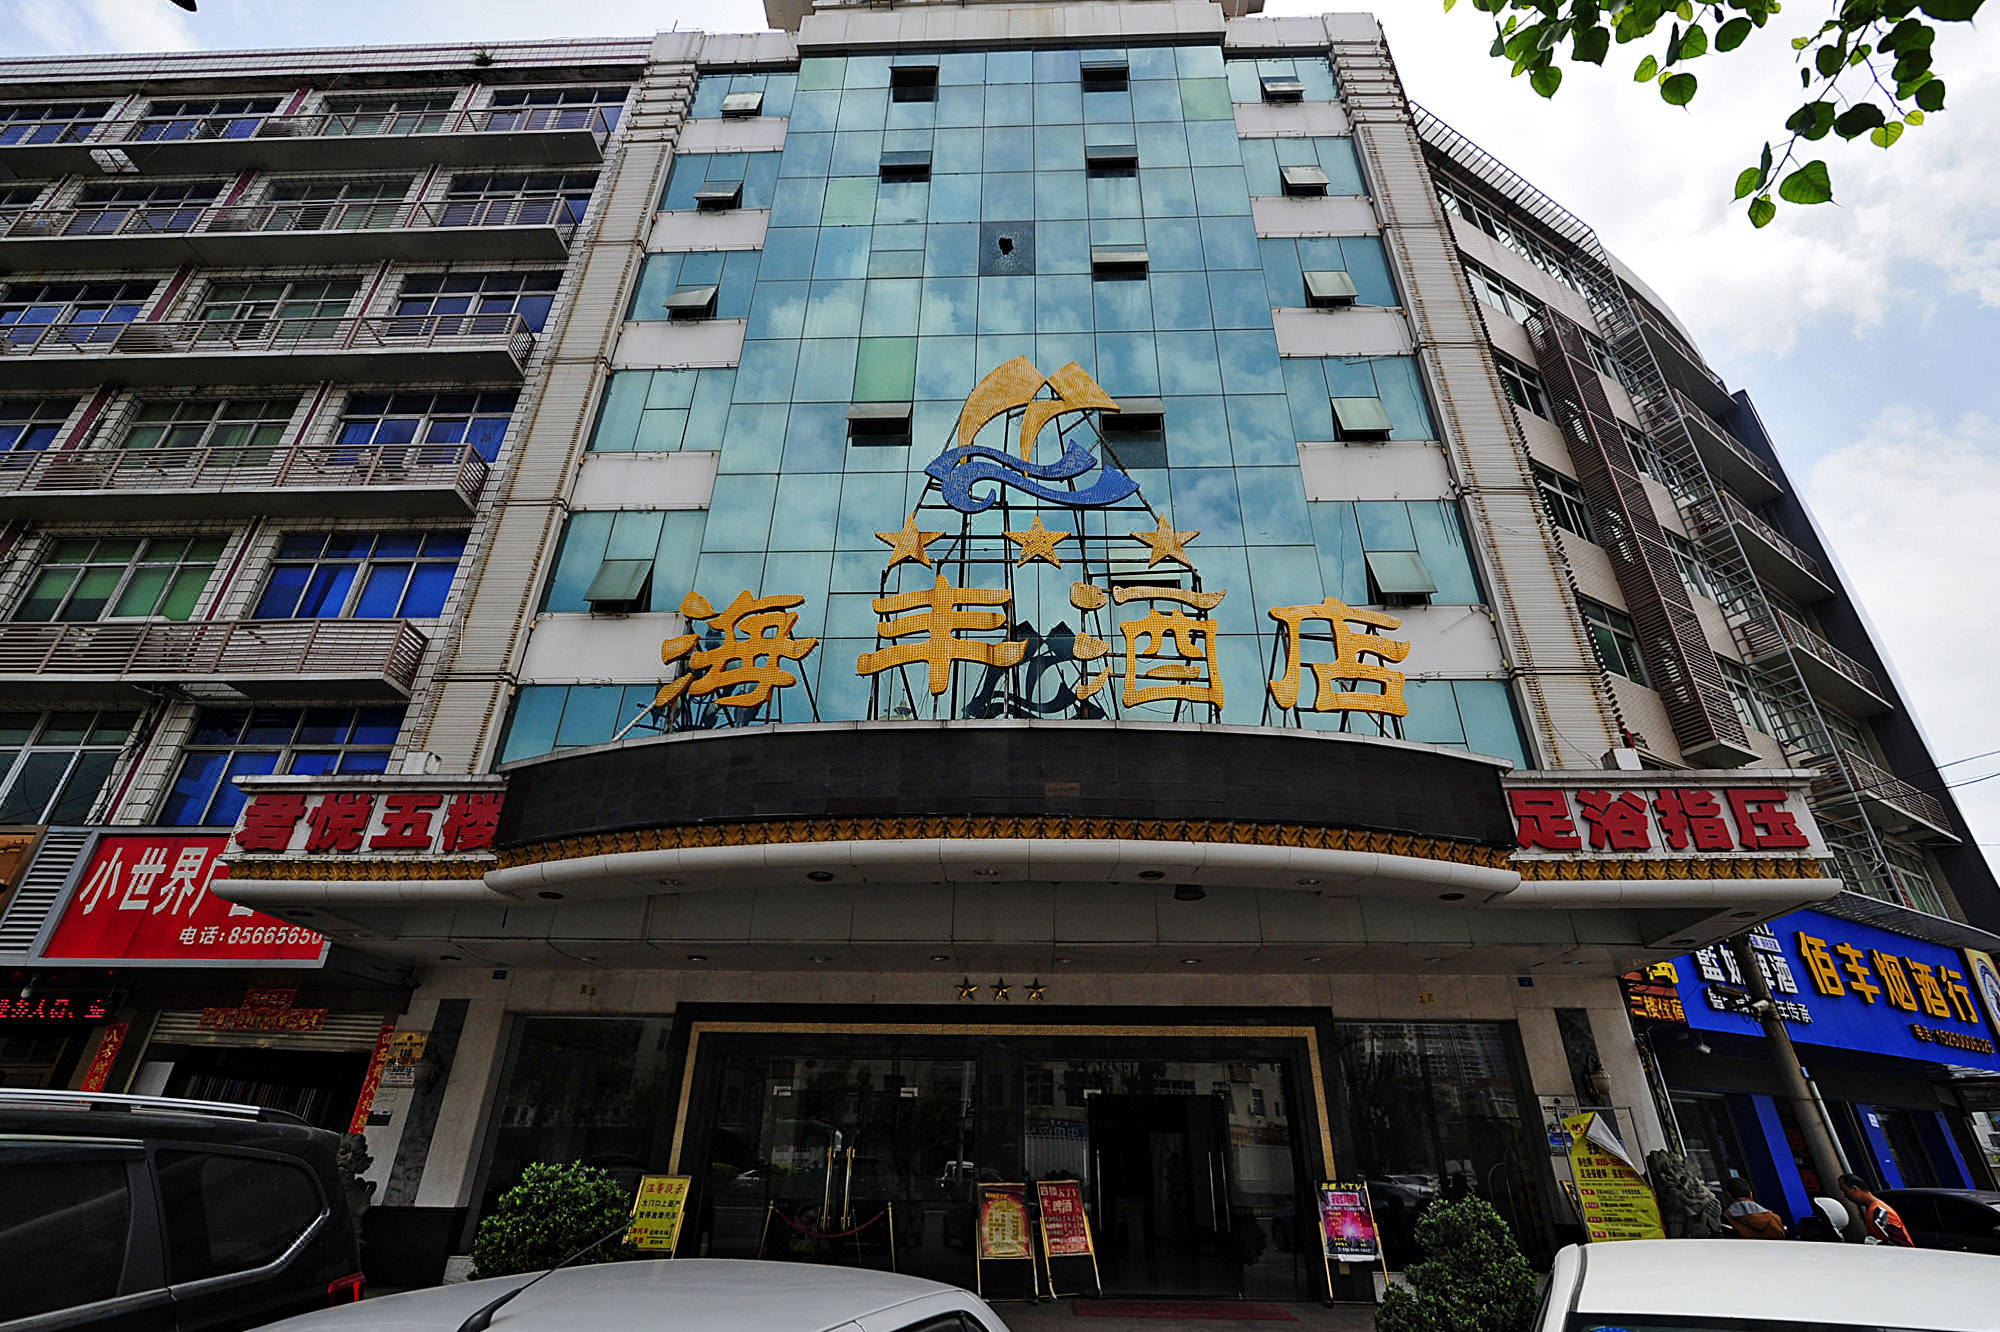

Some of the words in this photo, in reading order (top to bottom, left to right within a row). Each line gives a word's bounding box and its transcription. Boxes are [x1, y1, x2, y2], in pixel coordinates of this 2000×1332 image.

[654, 575, 1411, 717] 海丰酒店
[235, 792, 505, 851] 君悦五楼
[1509, 788, 1811, 851] 足浴指压
[1796, 931, 1979, 1024] 佰丰烟酒行
[1629, 995, 1687, 1023] 二楼住宿
[646, 1183, 683, 1194] 温馨提示
[1052, 1199, 1073, 1214] 啤酒
[1340, 1182, 1362, 1192] KTV
